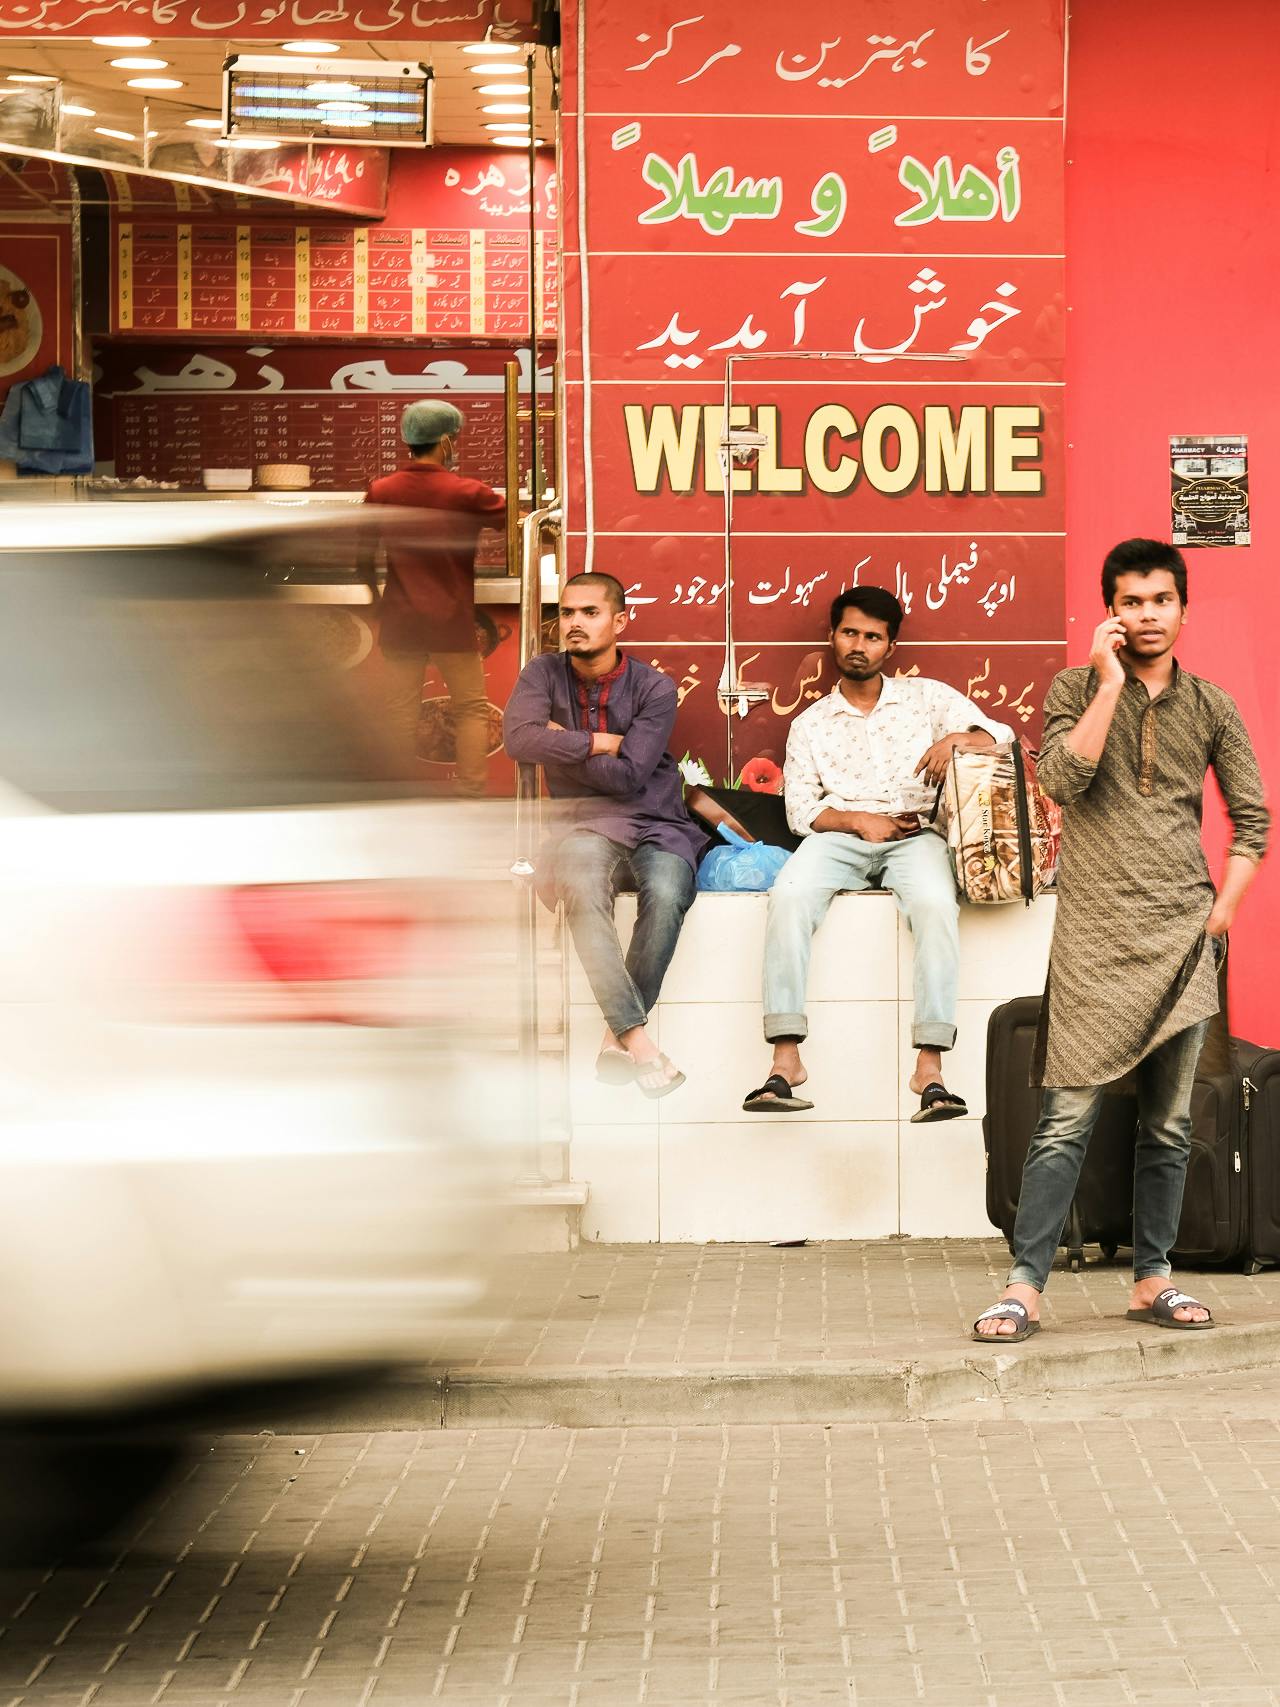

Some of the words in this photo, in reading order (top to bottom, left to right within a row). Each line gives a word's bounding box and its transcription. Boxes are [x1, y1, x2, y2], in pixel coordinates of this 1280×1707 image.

[625, 15, 742, 84] مرکز
[775, 28, 936, 89] بہترین
[964, 29, 1011, 76] کا
[636, 276, 827, 370] آمدید
[853, 267, 1023, 364] خوش
[623, 404, 1043, 495] WELCOME
[748, 566, 829, 607] سہولت
[926, 542, 979, 610] فیملی
[977, 575, 1016, 617] اوپر
